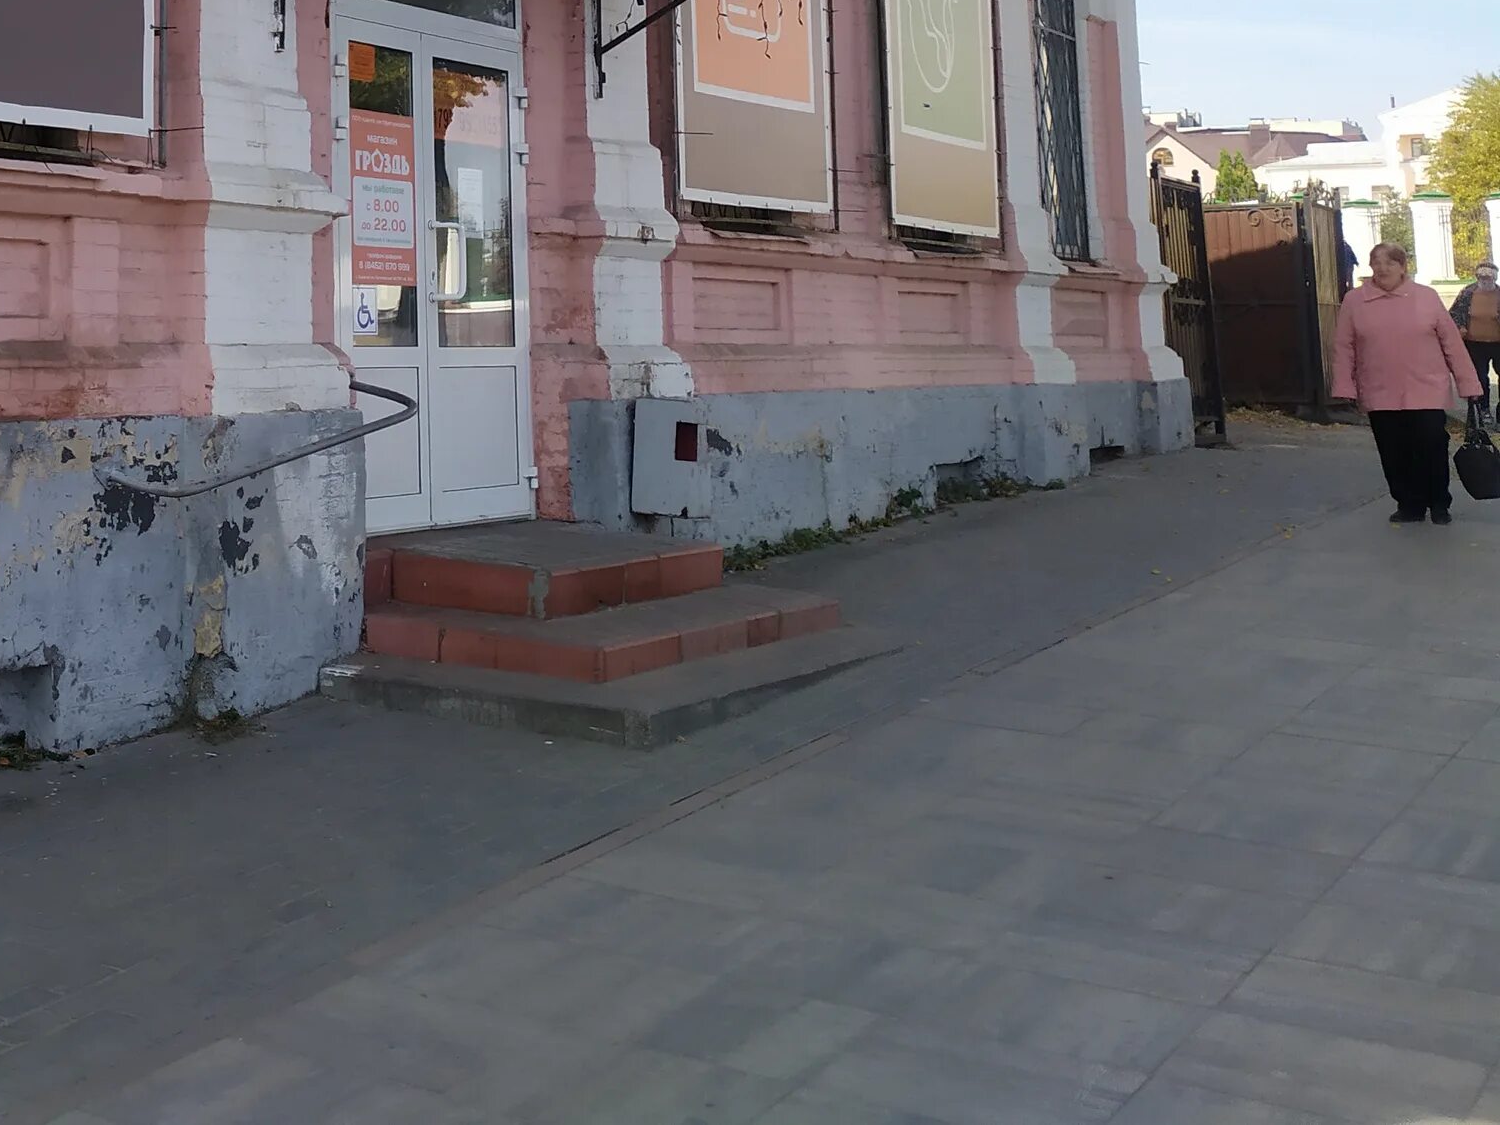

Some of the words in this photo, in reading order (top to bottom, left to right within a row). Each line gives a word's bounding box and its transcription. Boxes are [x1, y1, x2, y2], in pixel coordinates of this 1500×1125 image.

[366, 134, 398, 145] магазин
[355, 148, 410, 176] ГРОЗДЬ
[373, 198, 399, 213] 8.00
[374, 217, 406, 233] 22.00
